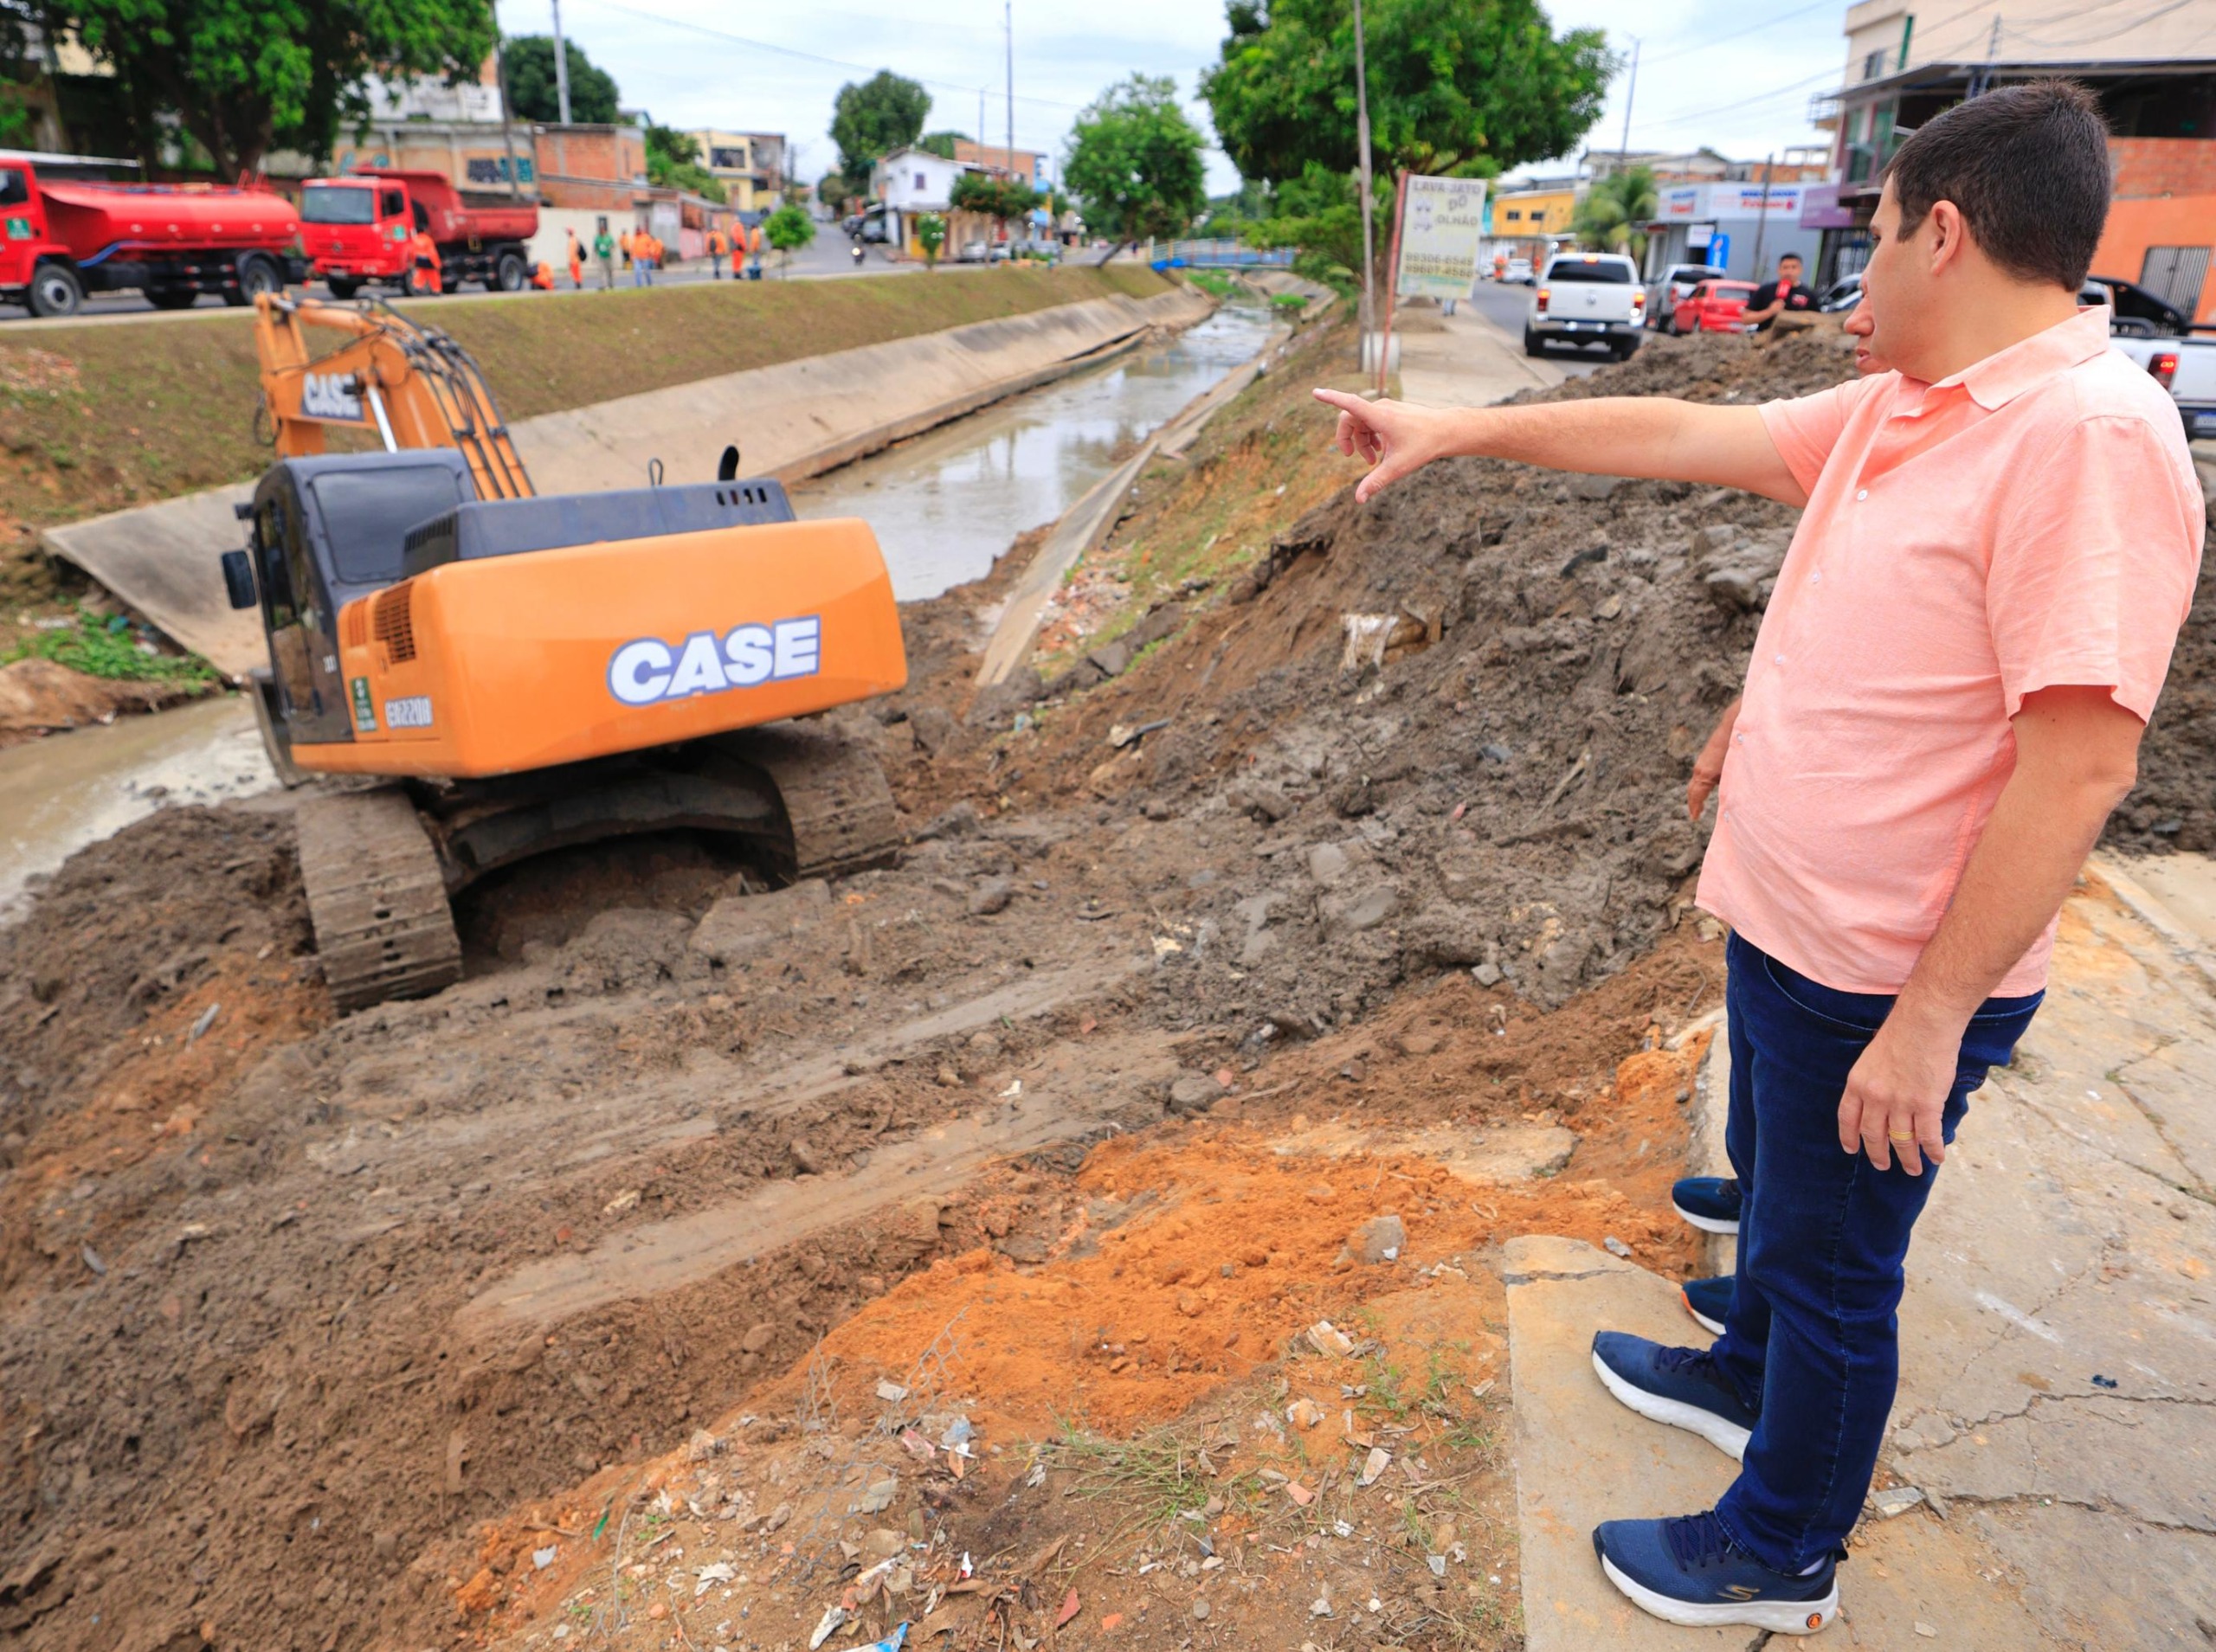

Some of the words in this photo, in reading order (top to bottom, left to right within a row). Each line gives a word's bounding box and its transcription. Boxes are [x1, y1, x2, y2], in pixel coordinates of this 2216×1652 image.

[1448, 194, 1468, 211] DO
[303, 371, 361, 417] CASE
[607, 615, 818, 705] CASE
